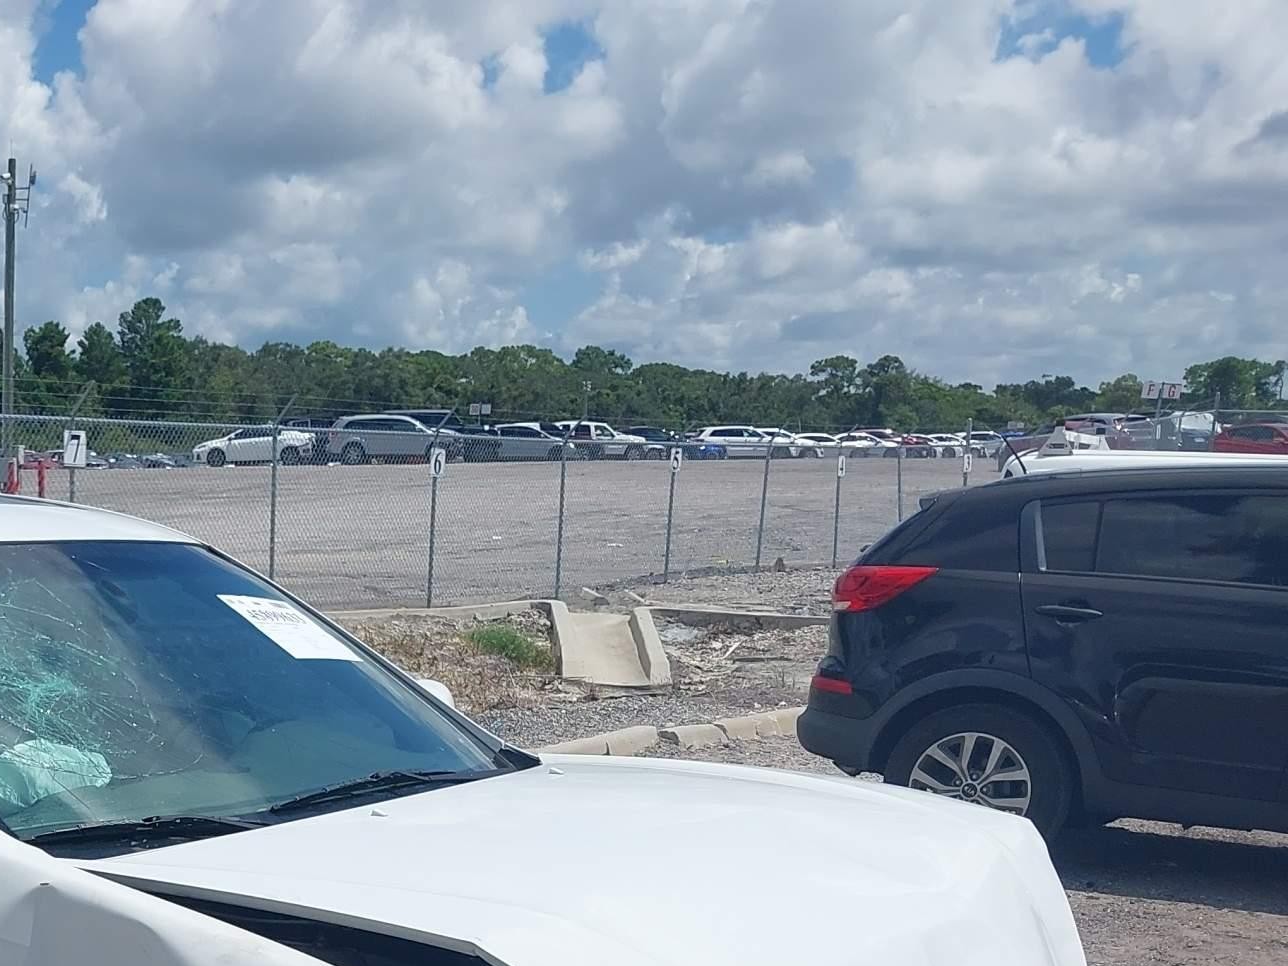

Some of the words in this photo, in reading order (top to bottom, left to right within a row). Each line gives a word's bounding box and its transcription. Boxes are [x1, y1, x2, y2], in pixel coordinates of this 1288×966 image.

[1147, 384, 1156, 396] F
[1168, 385, 1176, 398] G
[69, 434, 82, 464] 7
[434, 455, 442, 475] 6
[672, 450, 680, 471] 5
